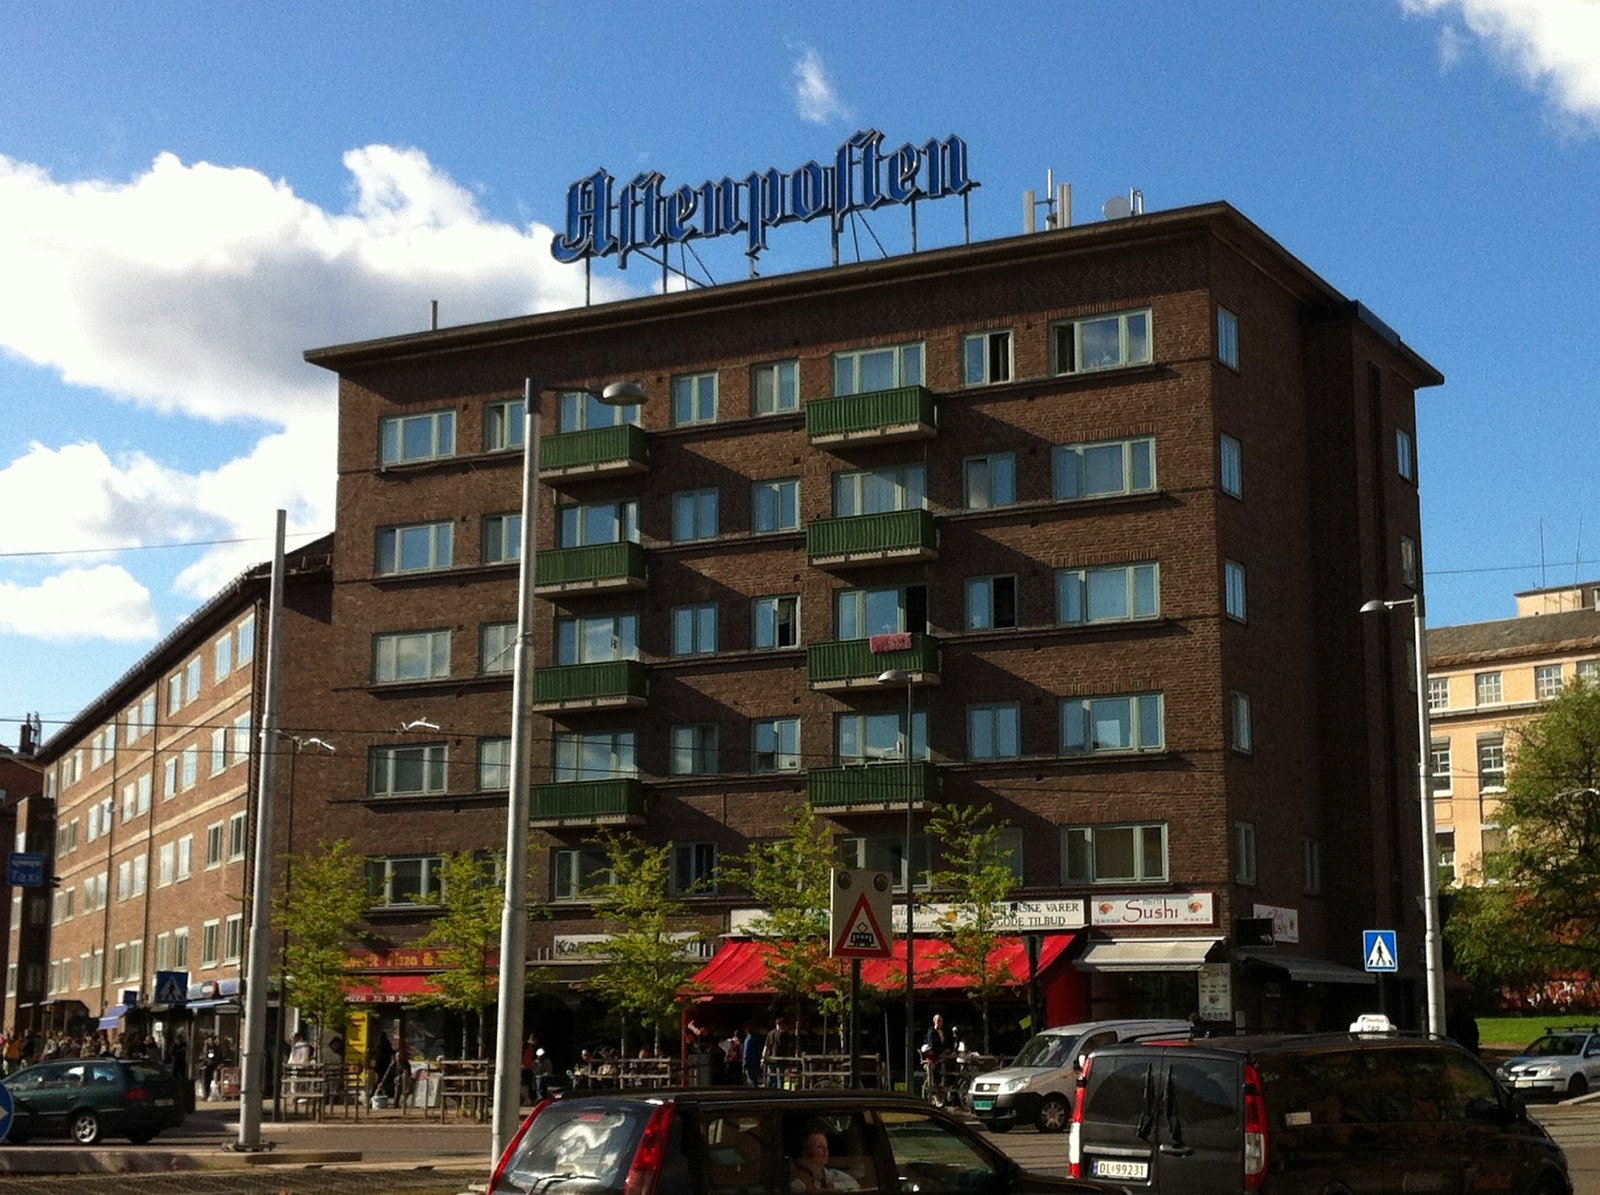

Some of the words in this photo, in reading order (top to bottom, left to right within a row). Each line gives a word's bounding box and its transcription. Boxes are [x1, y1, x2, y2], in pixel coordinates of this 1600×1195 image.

[551, 127, 981, 269] Aftenposten
[12, 870, 42, 884] Taxi
[1046, 902, 1080, 913] VARER
[1123, 899, 1179, 923] Sushi
[1028, 916, 1066, 927] TILBUD
